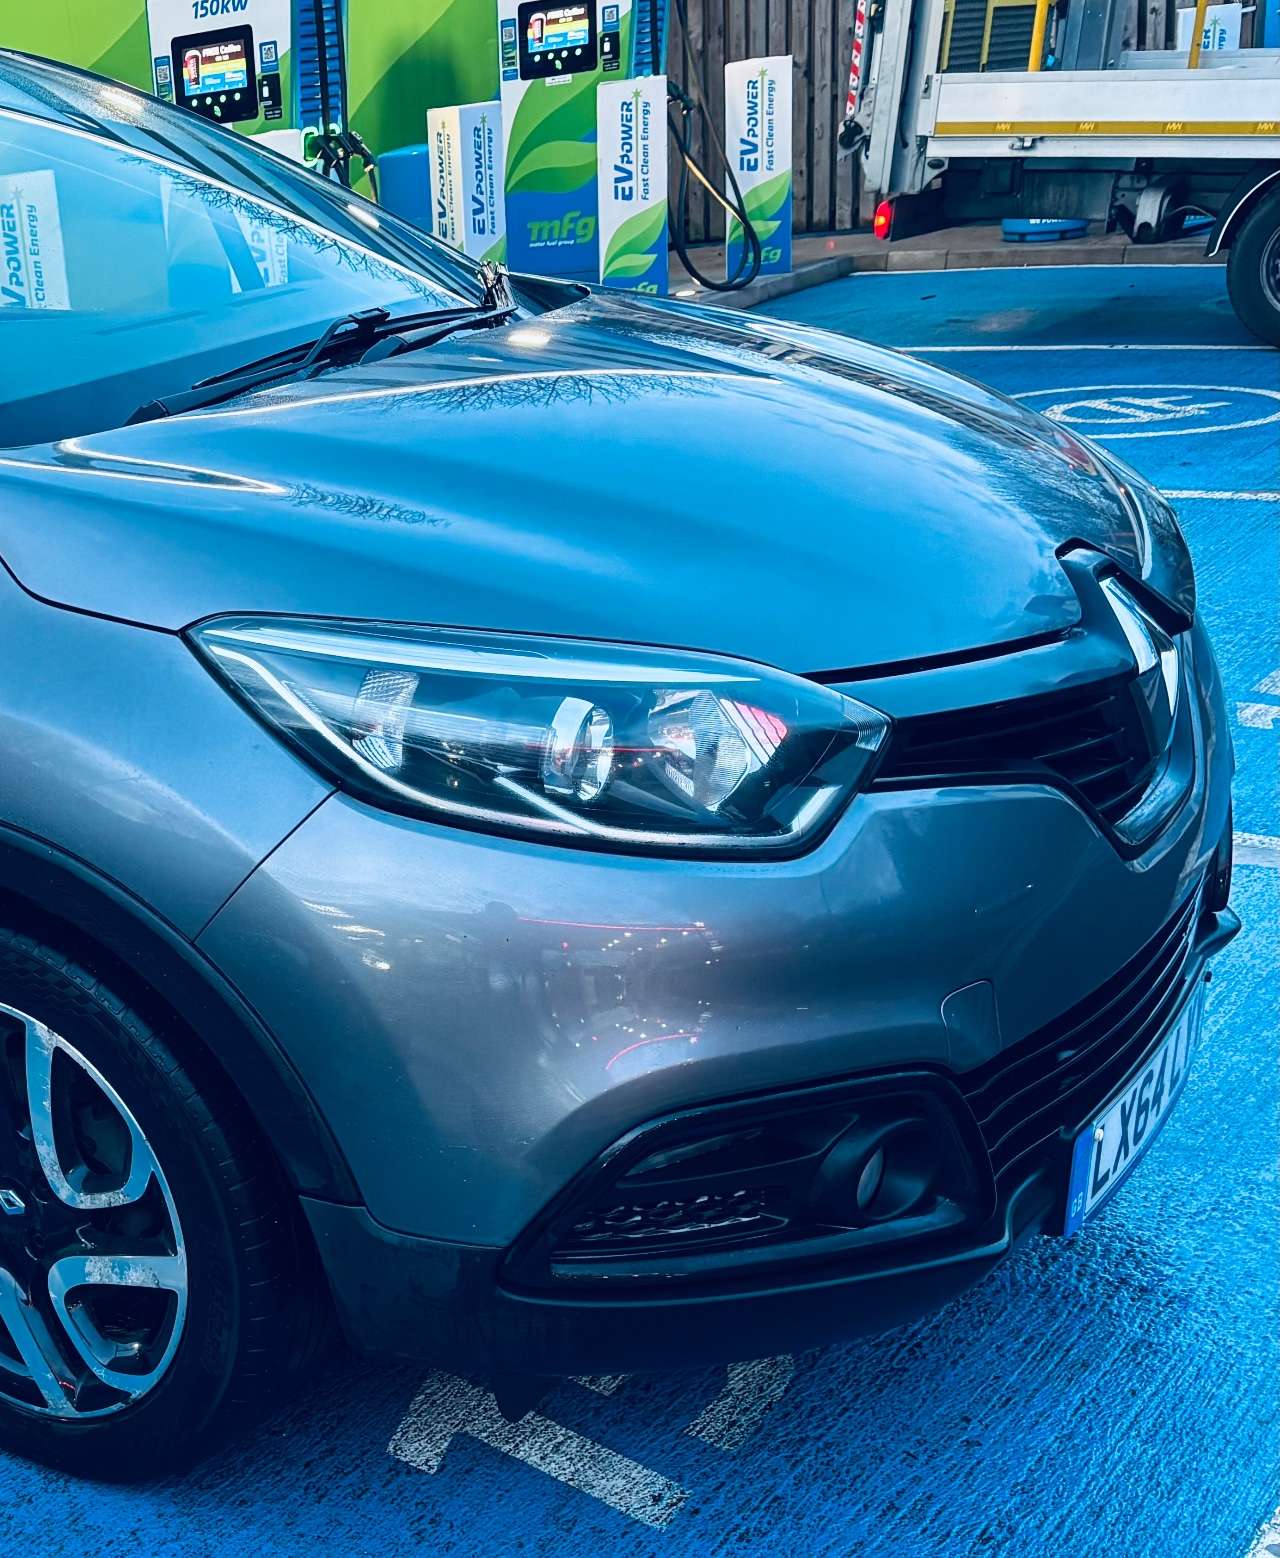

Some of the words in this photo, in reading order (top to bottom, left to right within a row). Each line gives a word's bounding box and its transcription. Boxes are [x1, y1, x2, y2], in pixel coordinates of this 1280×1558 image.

[192, 0, 248, 19] 150kW
[746, 79, 759, 138] POWER
[766, 79, 776, 115] Energy
[620, 100, 633, 165] POWER
[641, 101, 651, 141] Energy
[766, 119, 774, 147] Clean
[436, 131, 447, 199] POWER
[473, 126, 484, 195] POWER
[486, 127, 496, 171] Energy
[641, 145, 649, 175] Clean
[739, 137, 759, 172] EV
[766, 150, 774, 171] Fast
[614, 164, 634, 201] EV
[641, 176, 649, 201] Fast
[26, 204, 40, 256] Energy
[472, 194, 486, 235] EV
[527, 210, 595, 244] mfg
[0, 203, 24, 287] POWER
[34, 260, 46, 302] Clean
[1071, 1191, 1084, 1218] GB
